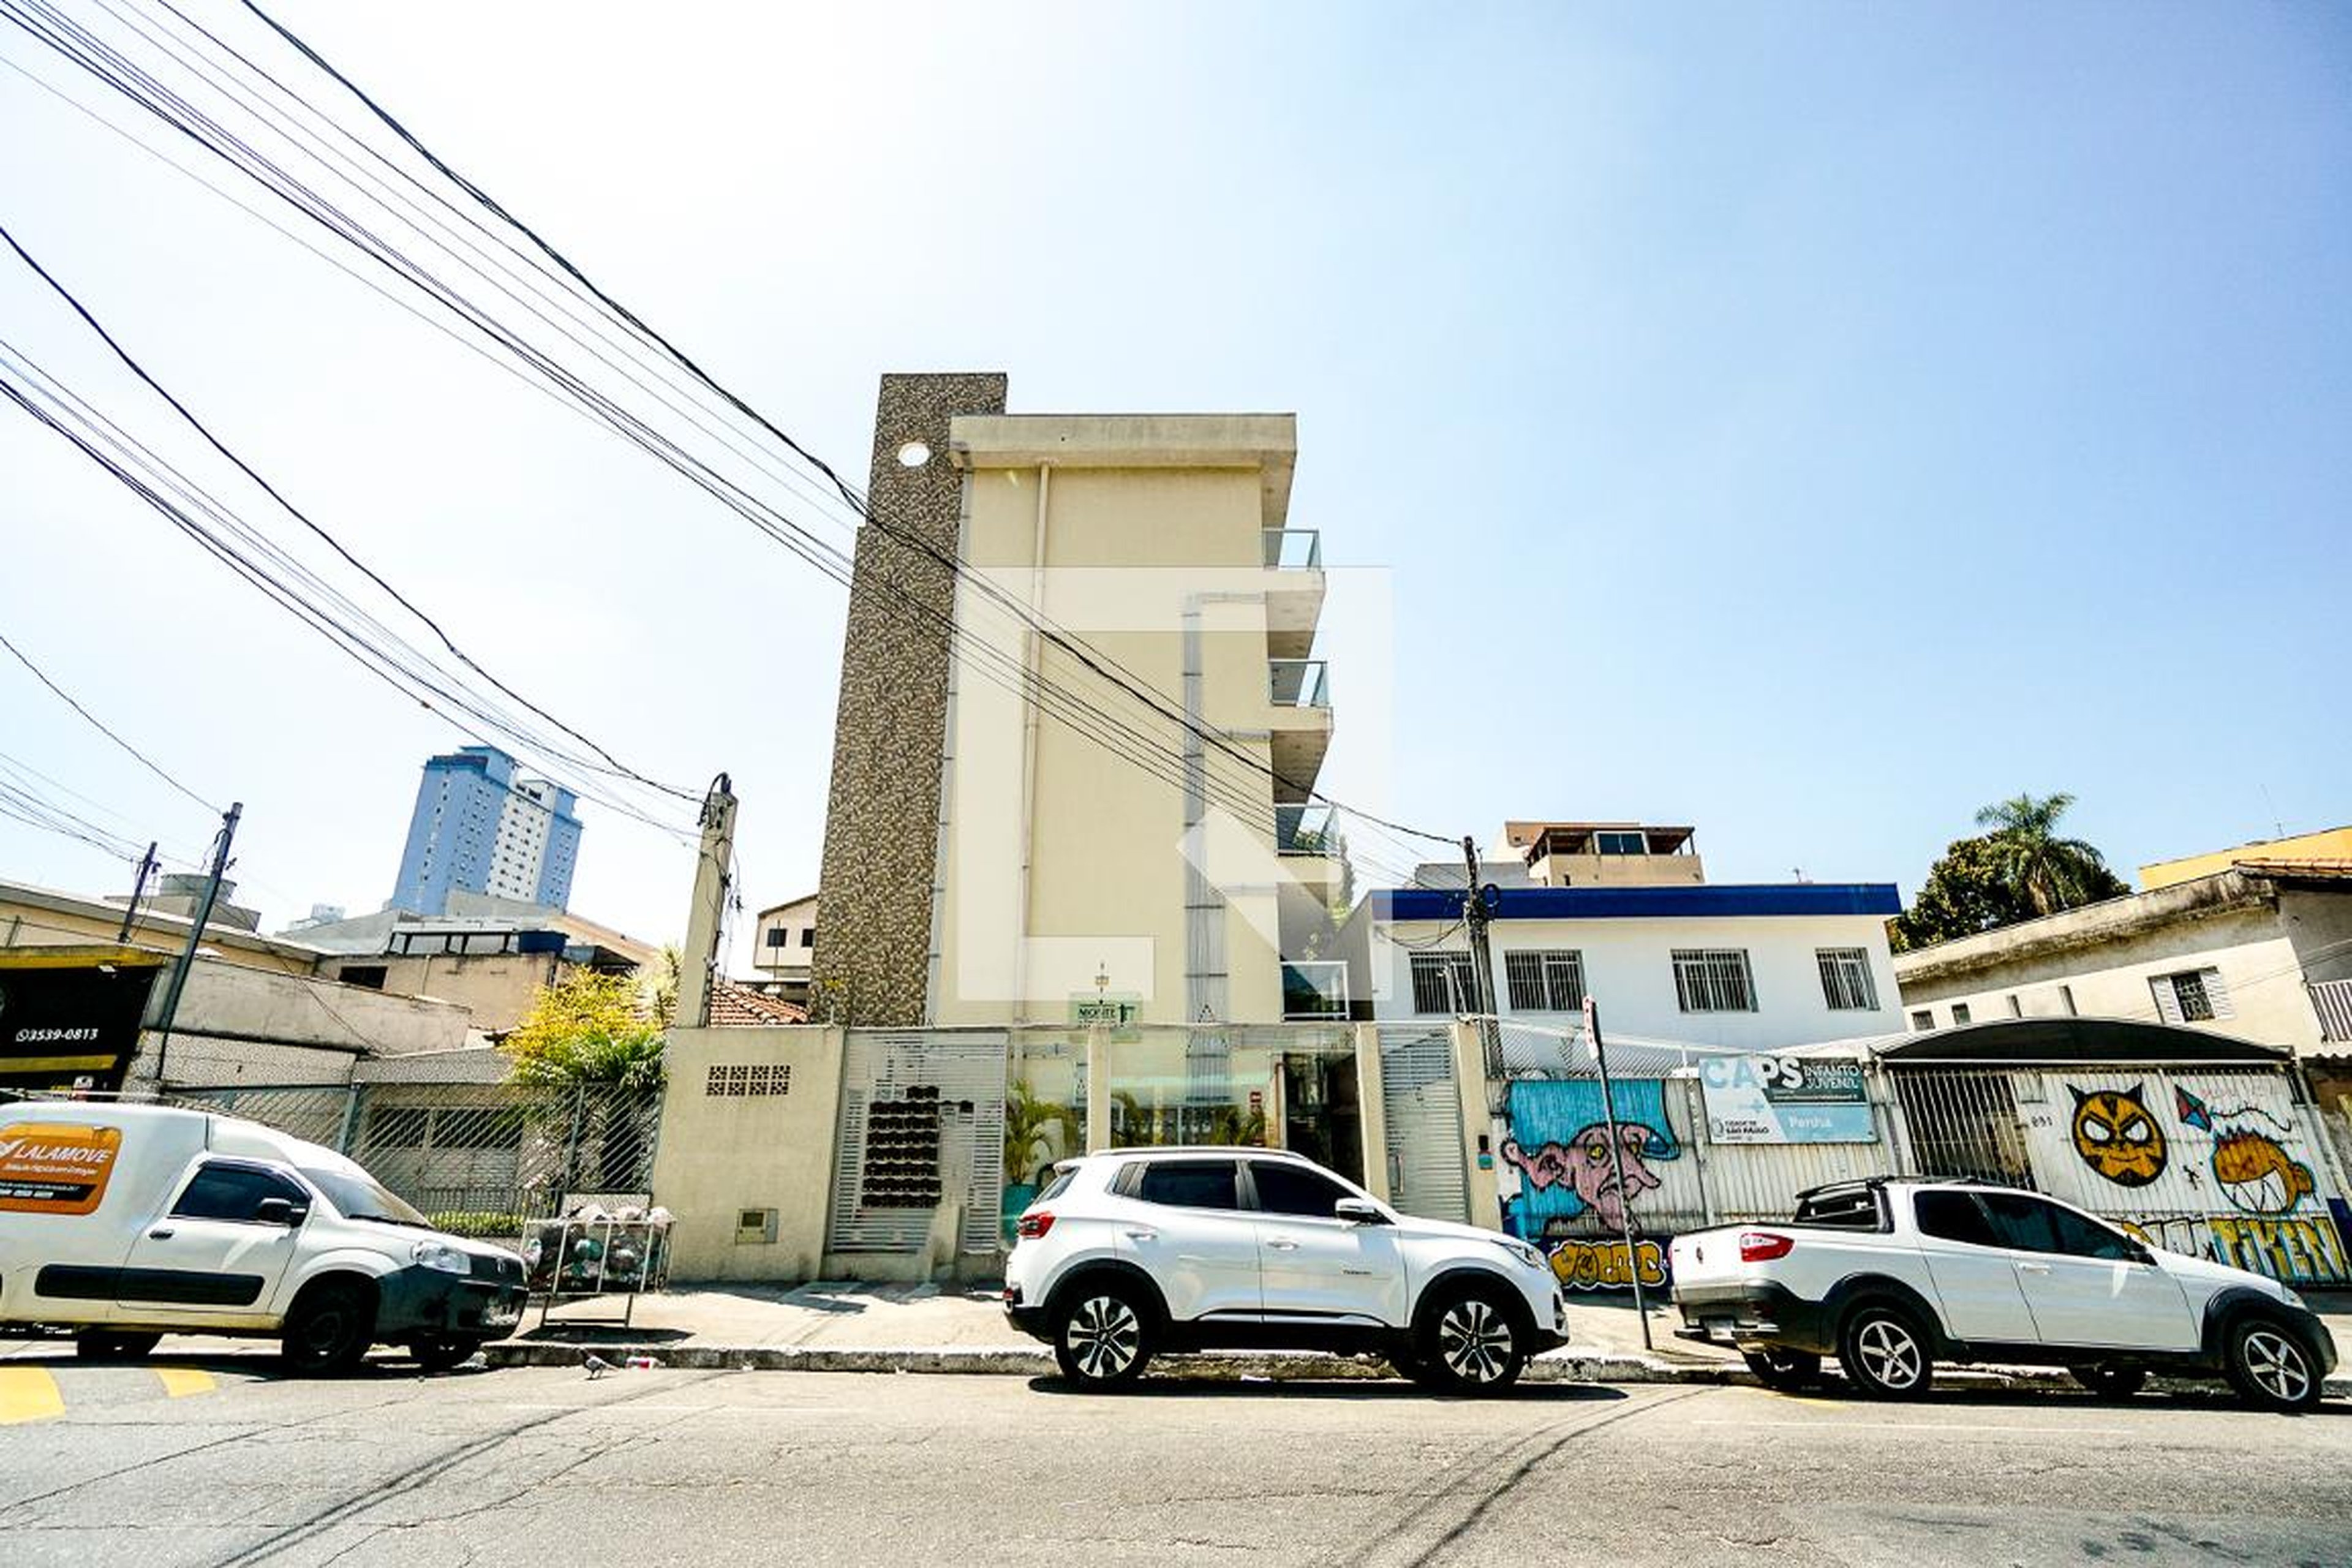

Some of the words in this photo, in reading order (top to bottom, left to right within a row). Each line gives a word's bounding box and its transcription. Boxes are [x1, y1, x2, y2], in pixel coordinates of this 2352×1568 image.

[28, 1028, 99, 1041] 3539-0813
[1699, 1056, 1804, 1090] CAPS
[1803, 1065, 1859, 1077] INFANTO
[1806, 1077, 1860, 1089] JUVENIL
[13, 1144, 114, 1163] LALAMOVE
